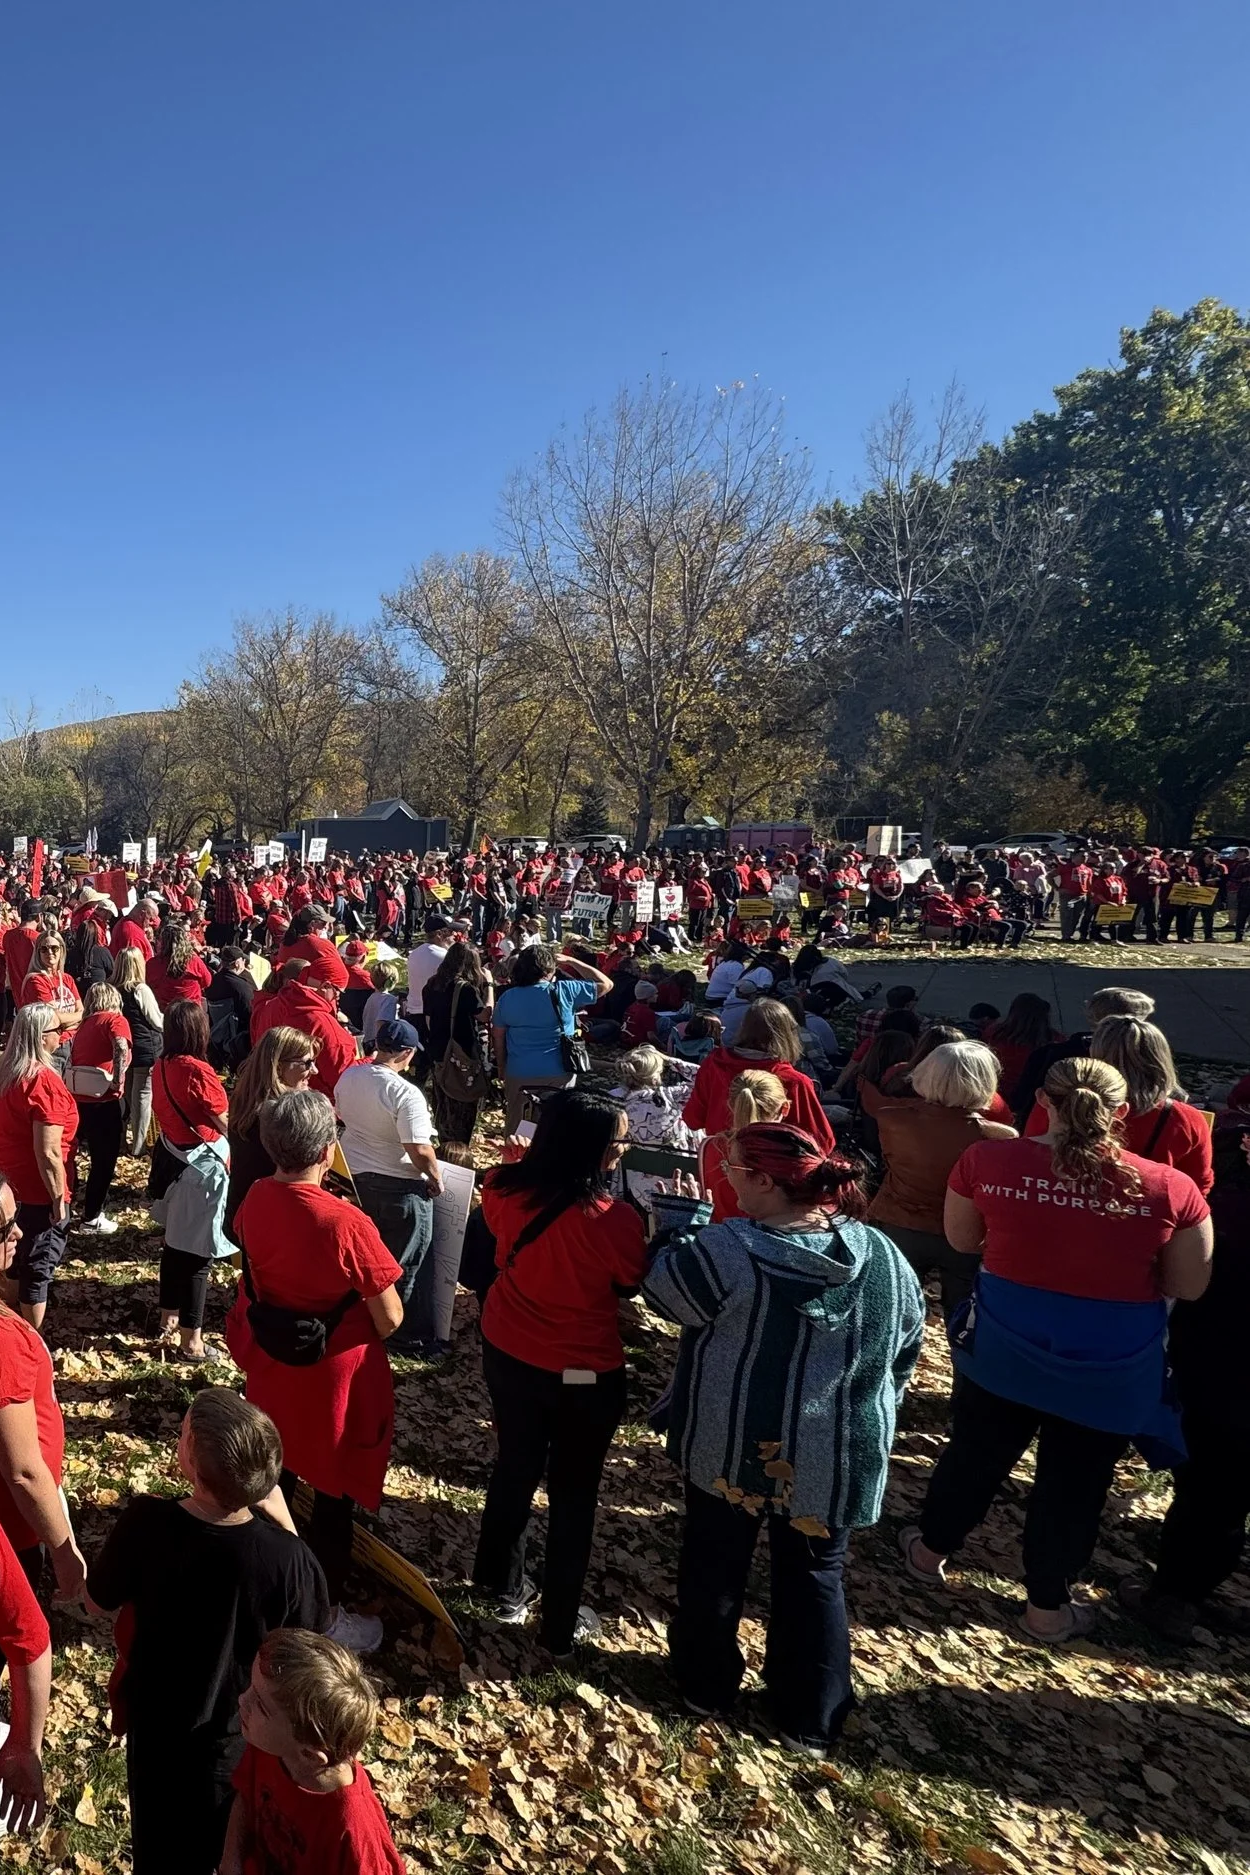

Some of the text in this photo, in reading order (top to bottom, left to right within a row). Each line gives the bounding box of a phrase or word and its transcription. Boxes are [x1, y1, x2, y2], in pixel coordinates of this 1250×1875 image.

[572, 907, 605, 920] FUTURE
[979, 1182, 1153, 1218] WITH PURPOSE
